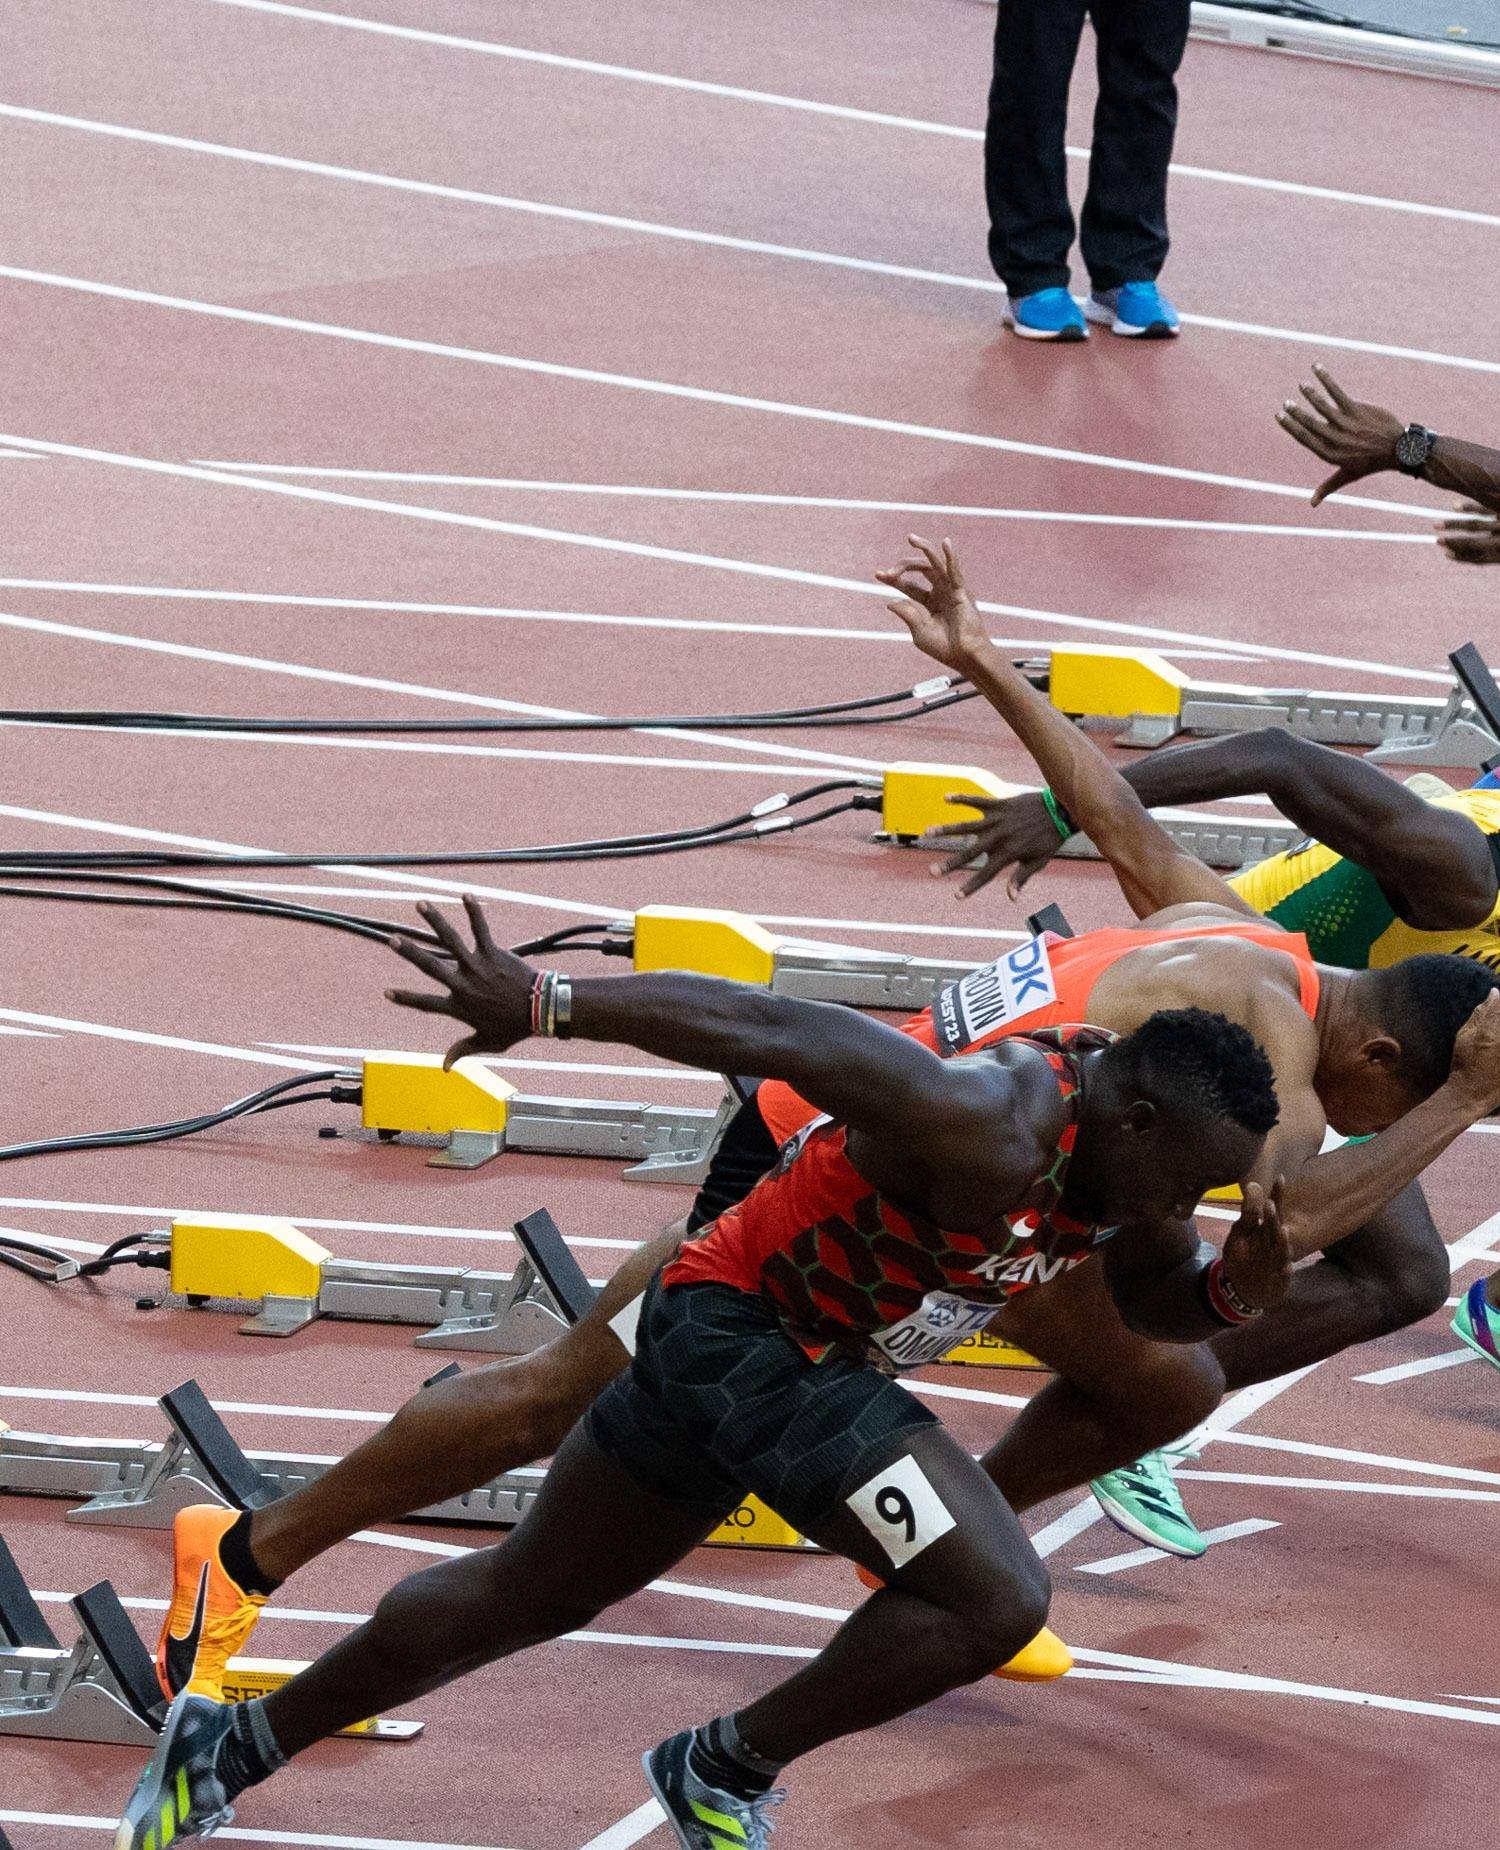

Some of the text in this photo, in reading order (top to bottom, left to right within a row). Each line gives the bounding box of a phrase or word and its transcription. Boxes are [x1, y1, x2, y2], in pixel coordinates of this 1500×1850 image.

[964, 961, 1006, 1032] ROWN
[1008, 937, 1048, 1006] DK
[944, 1022, 960, 1042] 23
[875, 1486, 916, 1543] 9
[221, 1685, 275, 1704] SE
